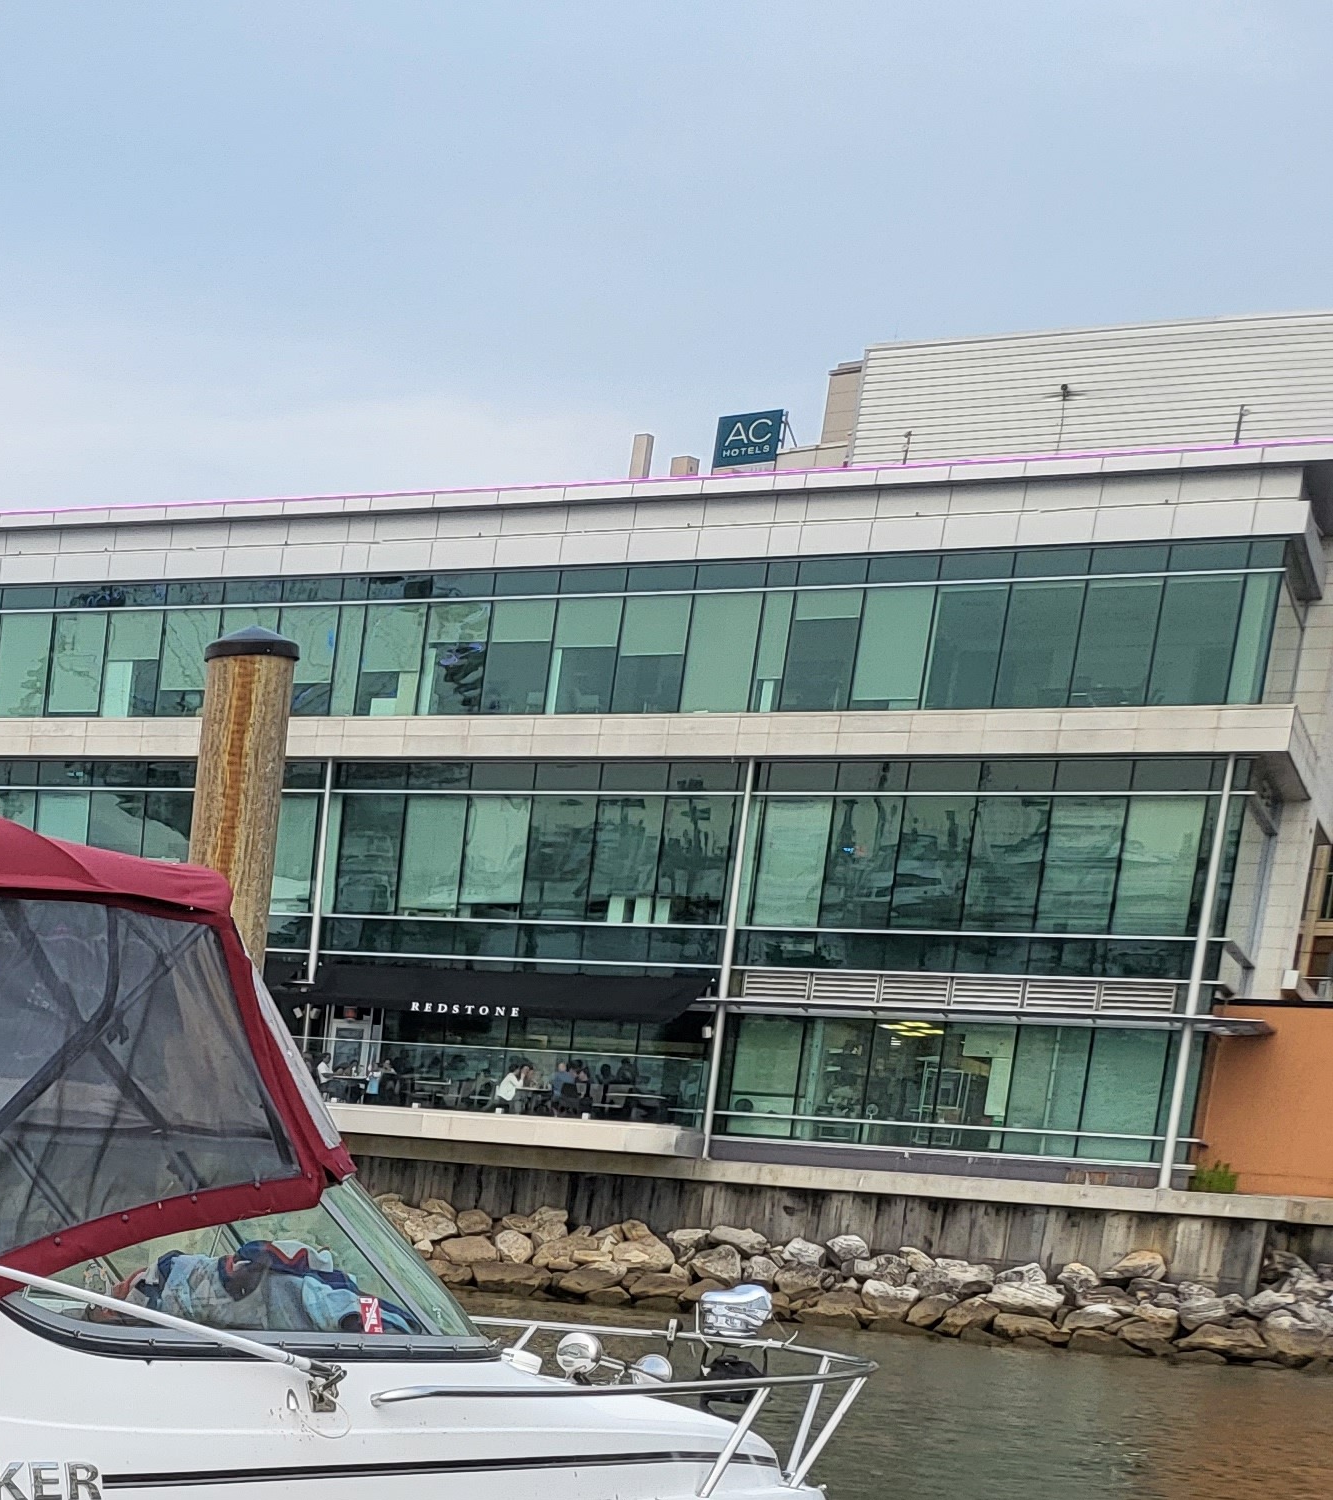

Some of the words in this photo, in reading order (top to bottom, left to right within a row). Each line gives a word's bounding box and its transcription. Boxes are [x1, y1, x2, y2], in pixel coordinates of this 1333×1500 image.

[724, 418, 773, 447] AC
[722, 444, 770, 458] HOTELS
[410, 1001, 520, 1017] REDSTONE
